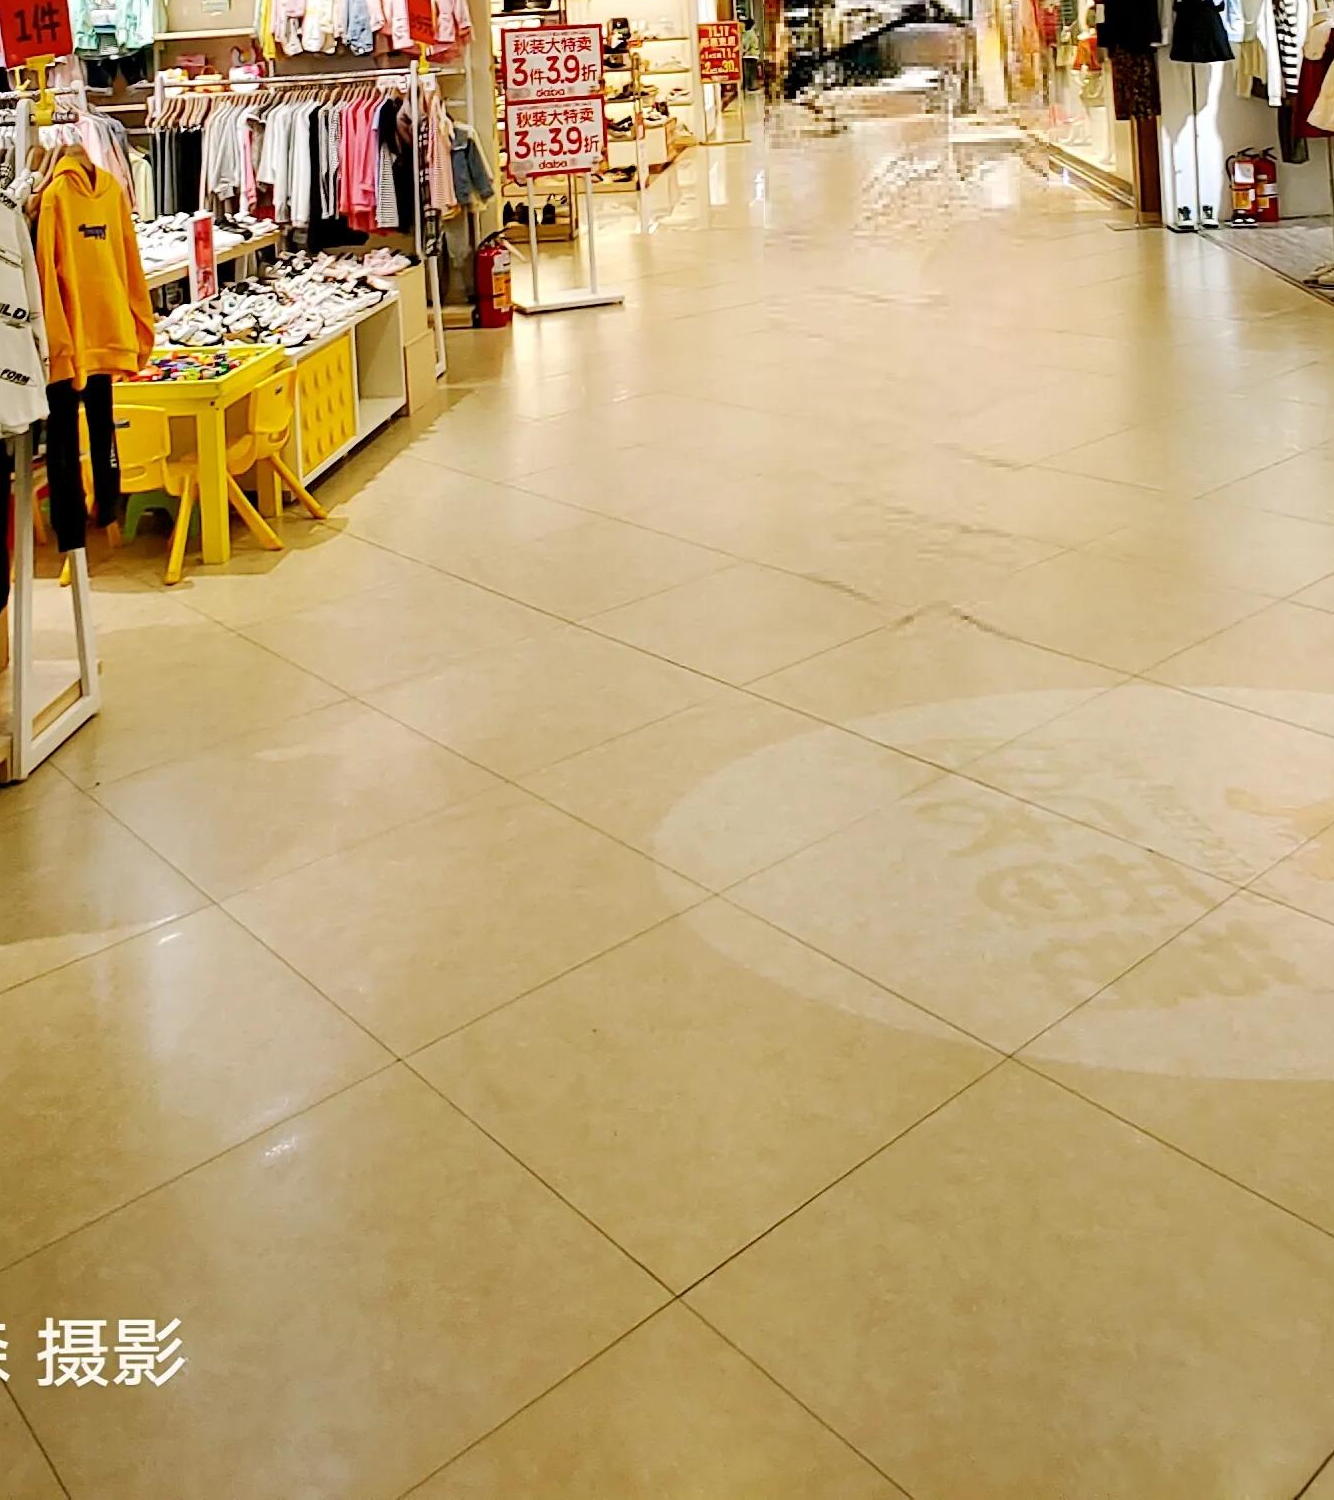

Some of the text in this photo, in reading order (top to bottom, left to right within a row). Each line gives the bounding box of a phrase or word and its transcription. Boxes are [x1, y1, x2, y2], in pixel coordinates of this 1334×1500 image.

[14, 1, 60, 45] 1件
[513, 37, 592, 55] 秋装大特卖
[512, 55, 597, 86] 3件3.9折
[516, 108, 594, 128] 秋装大特卖
[515, 127, 600, 159] 3件3.9折
